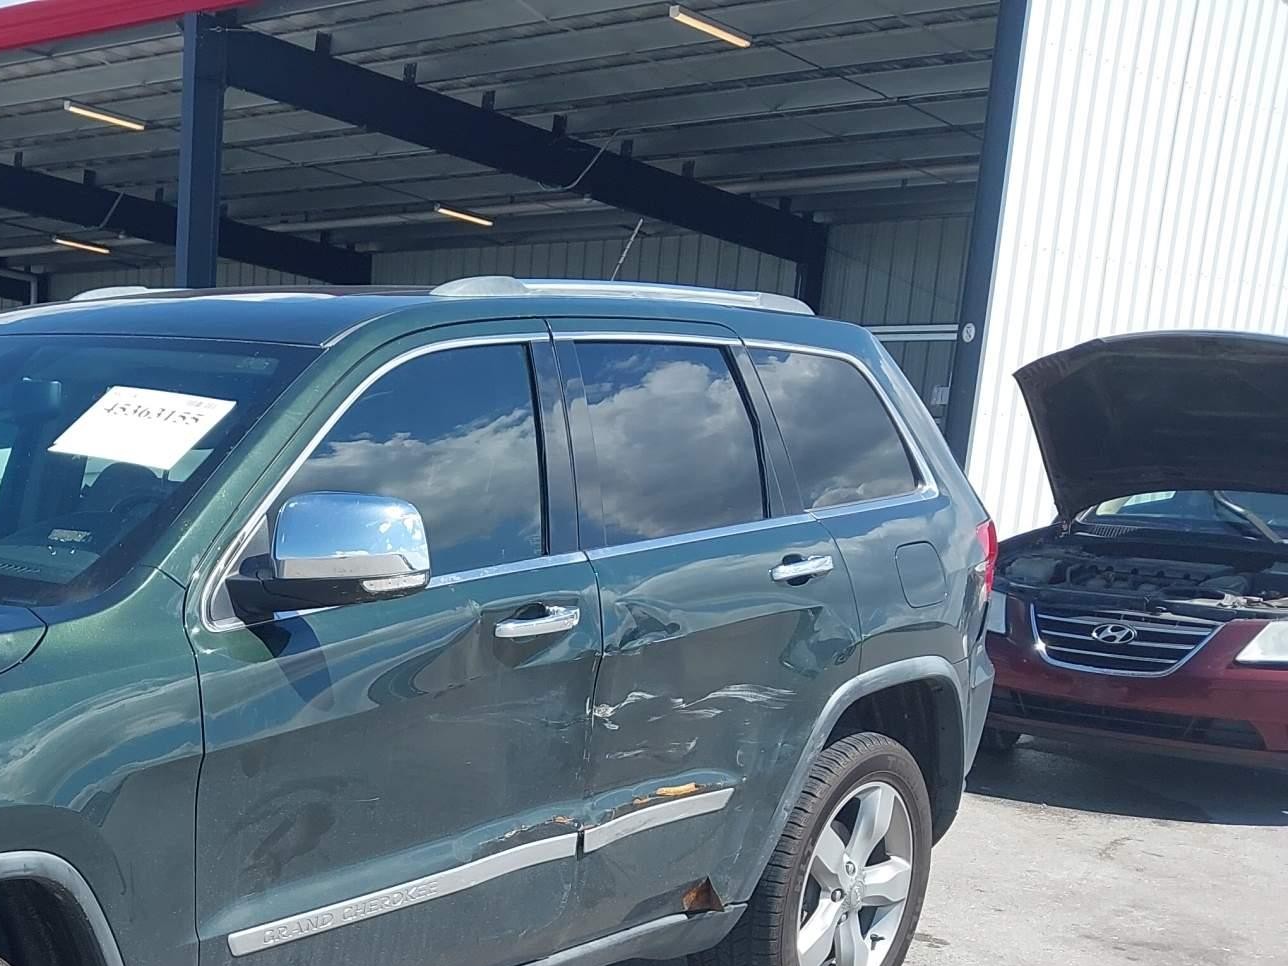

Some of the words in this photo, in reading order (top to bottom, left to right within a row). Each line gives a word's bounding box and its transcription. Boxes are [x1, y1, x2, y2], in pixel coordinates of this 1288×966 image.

[103, 401, 206, 425] 45363155
[263, 912, 335, 945] GRAND
[341, 881, 439, 922] CHEROKEE
